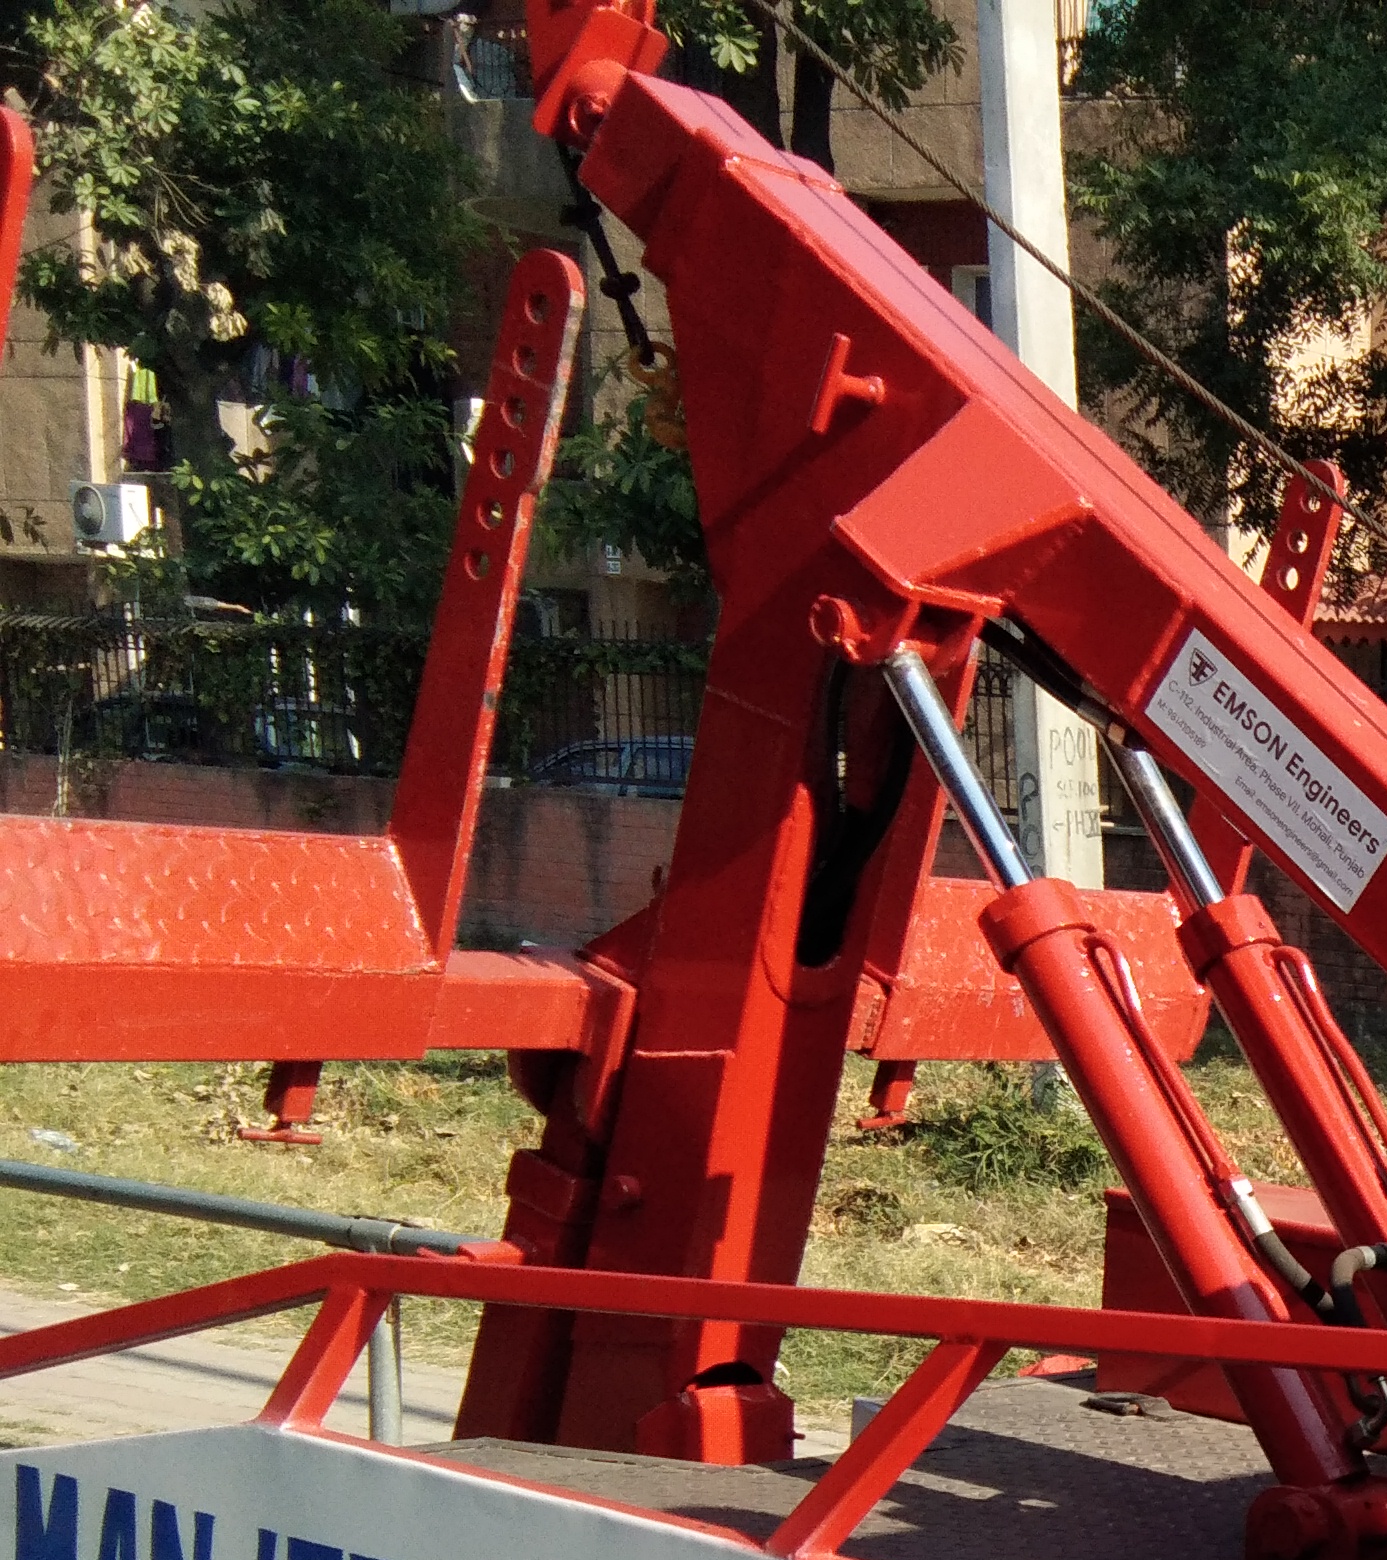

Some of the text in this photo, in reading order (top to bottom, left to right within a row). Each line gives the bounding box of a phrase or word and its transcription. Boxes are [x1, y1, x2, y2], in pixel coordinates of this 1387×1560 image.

[1195, 706, 1237, 751] Industrial
[1259, 769, 1287, 800] Phase
[1333, 842, 1365, 879] Punjab
[1213, 680, 1380, 855] EMSON Engineers
